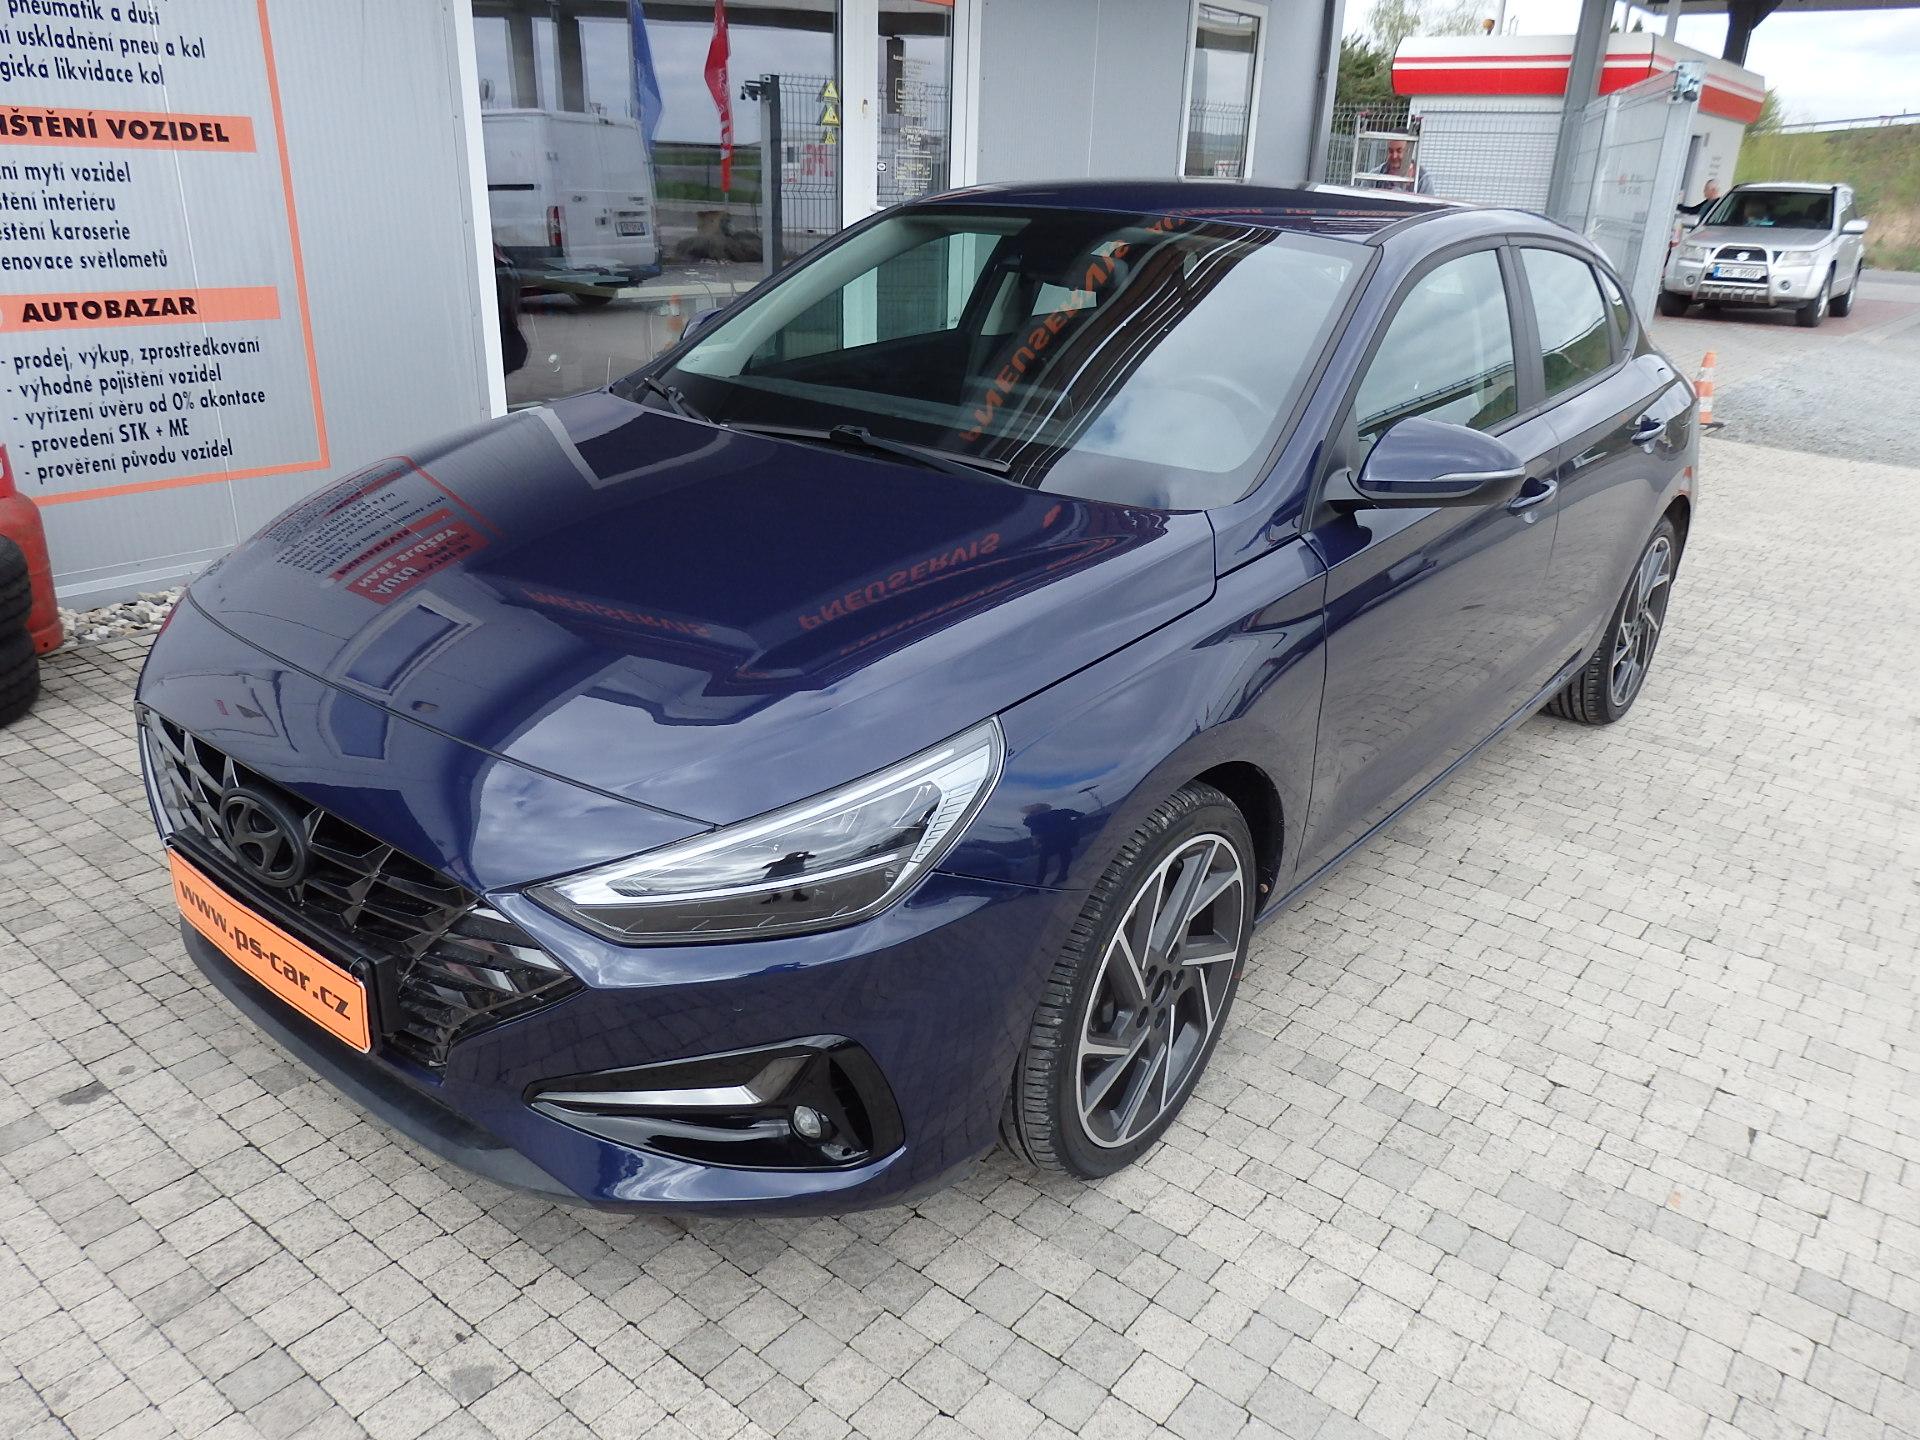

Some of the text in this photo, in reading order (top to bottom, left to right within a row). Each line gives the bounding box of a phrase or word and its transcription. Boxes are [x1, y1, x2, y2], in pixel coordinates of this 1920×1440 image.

[8, 0, 104, 18] pneumatik
[111, 7, 121, 21] a
[17, 23, 114, 52] uskladnění
[120, 38, 160, 58] pneu
[166, 42, 175, 56] a
[180, 35, 205, 58] kol
[54, 56, 134, 83] likvidace
[138, 62, 164, 85] kol
[106, 118, 230, 143] VOZIDEL
[24, 161, 66, 187] mytí
[71, 160, 131, 183] vozidel
[42, 189, 116, 212] interiéru
[50, 218, 131, 241] karoserie
[80, 247, 168, 270] světlometů
[22, 296, 198, 323] AUTOBAZAR
[14, 346, 73, 375] prodej,
[79, 343, 134, 369] výkup,
[140, 336, 261, 365] zprostředkování
[20, 374, 93, 403] výhodné
[100, 369, 164, 396] pojištění
[169, 362, 222, 385] vozidel
[26, 402, 94, 430] vyřízení
[100, 400, 144, 418] úvěru
[150, 393, 167, 413] od
[173, 390, 195, 411] 0%
[200, 388, 266, 408] akontace
[32, 427, 114, 458] provedení
[119, 421, 150, 443] STK
[169, 417, 190, 438] ME
[38, 453, 116, 485] prověření
[121, 450, 176, 474] původu
[182, 437, 233, 461] vozidel
[178, 879, 351, 1021] www.ps-car.cz
